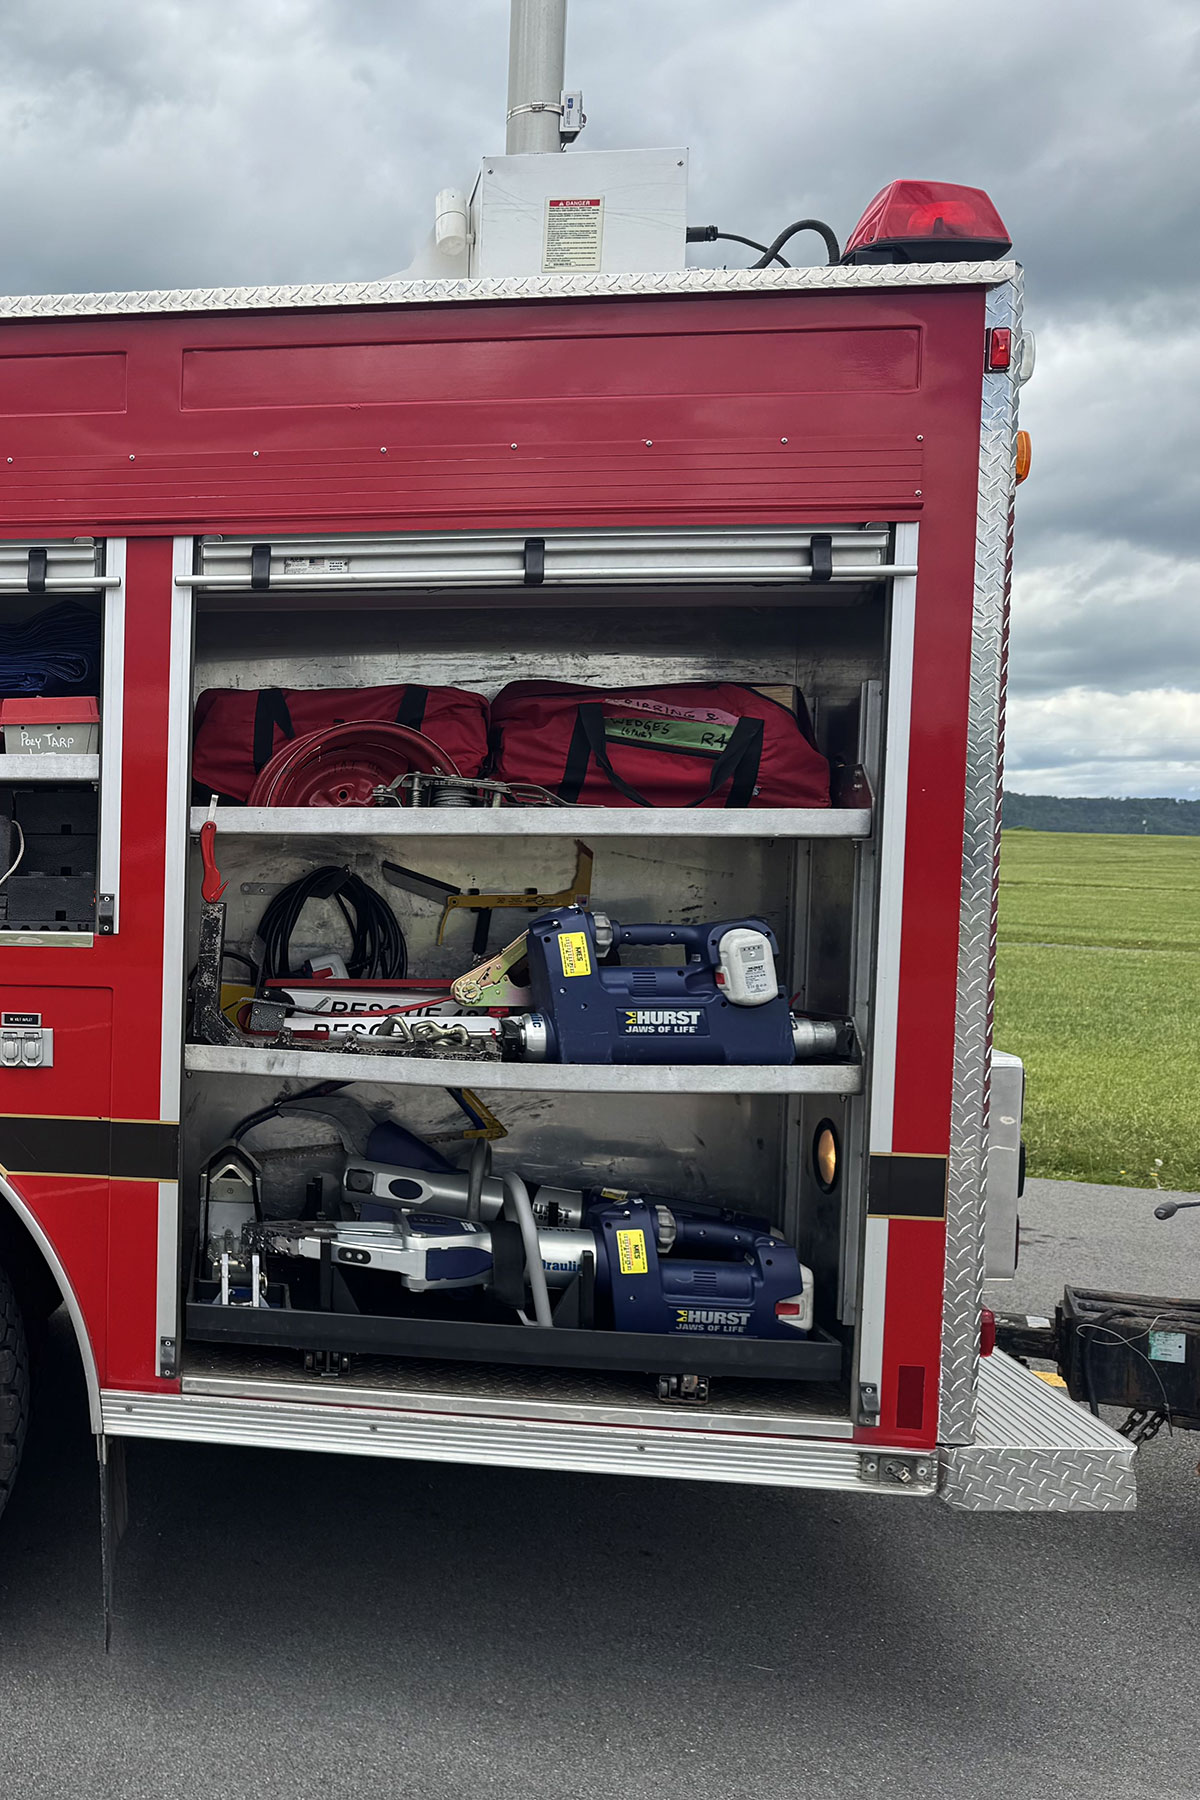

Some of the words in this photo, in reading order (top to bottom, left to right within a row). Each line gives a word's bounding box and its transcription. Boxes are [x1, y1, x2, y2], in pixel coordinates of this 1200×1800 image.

[42, 733, 75, 749] TARP
[637, 1011, 701, 1025] HURST
[688, 1310, 751, 1325] HURST
[675, 1323, 705, 1331] JAWS
